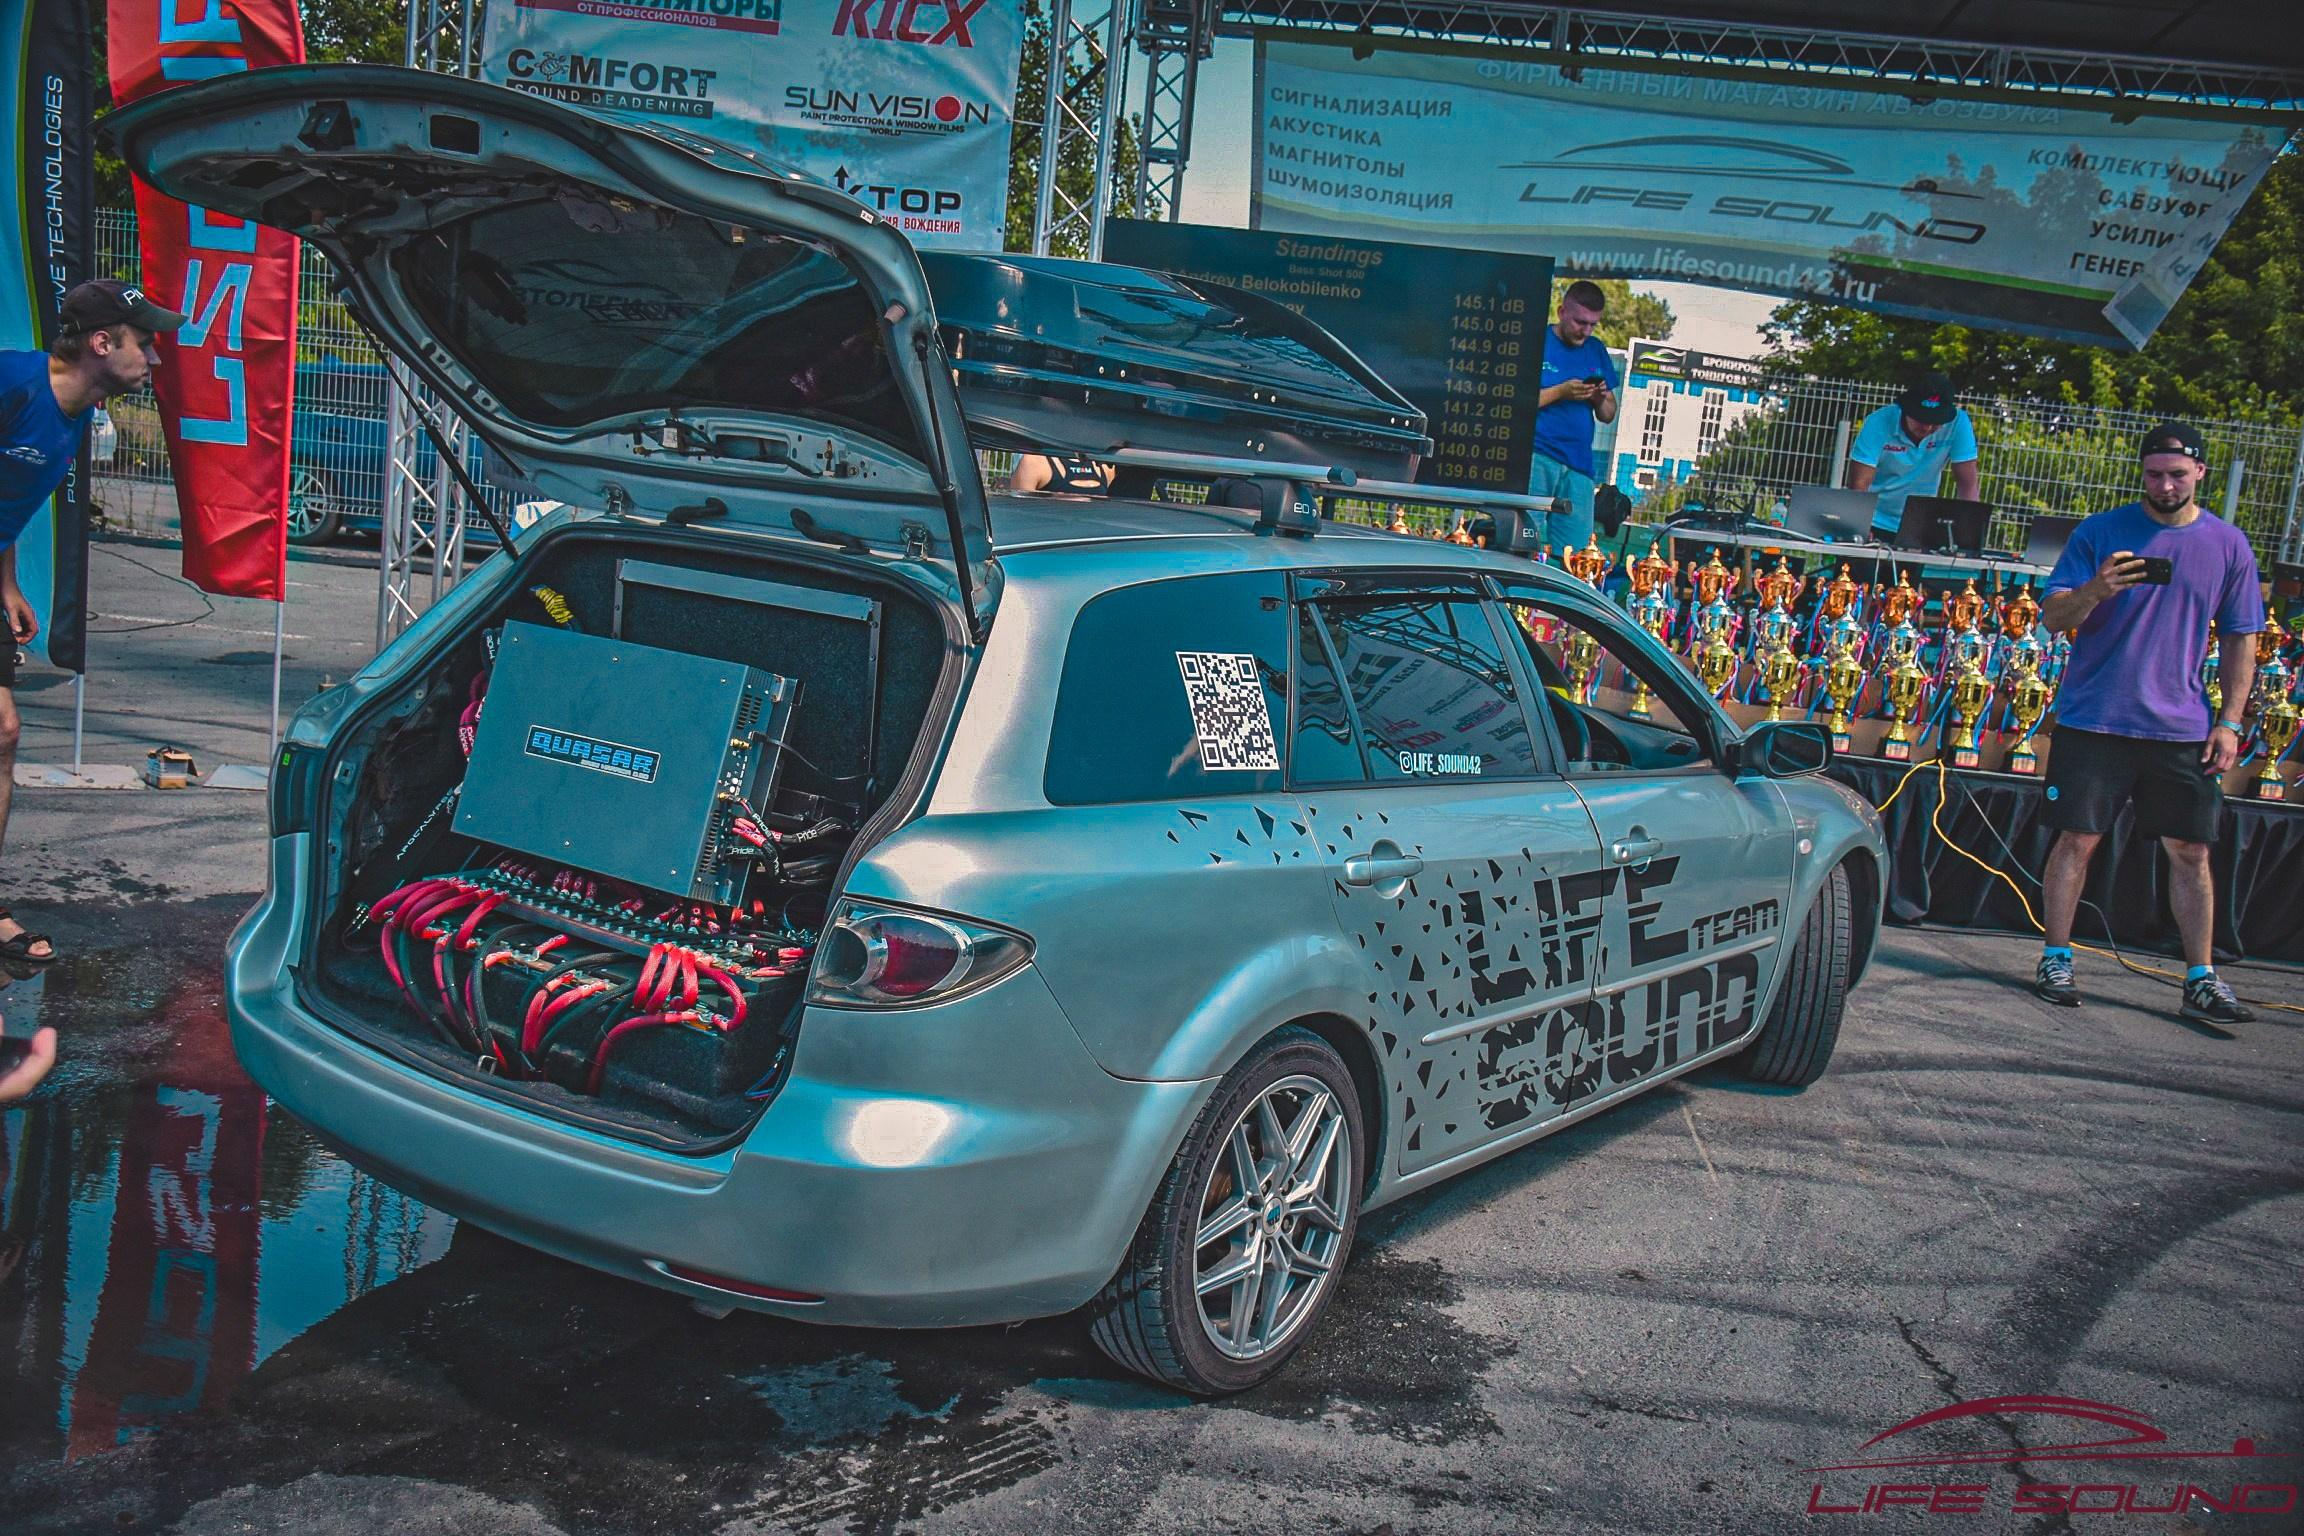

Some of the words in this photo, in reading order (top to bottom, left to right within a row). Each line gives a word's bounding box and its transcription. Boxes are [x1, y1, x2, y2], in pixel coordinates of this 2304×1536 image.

[577, 3, 593, 13] ОТ
[597, 5, 717, 26] ПРОФЕССИОНАЛОВ
[832, 0, 987, 47] KICX
[515, 84, 580, 102] SOUND
[592, 93, 704, 115] DEADENING
[784, 86, 858, 113] SUN
[1270, 87, 1452, 119] СИГНАЛИЗАЦИЯ
[1477, 60, 1691, 99] ФИРМЕННЫЙ
[1702, 79, 1858, 112] МАГАЗИН
[1868, 94, 2062, 124] АВТОЗВУКА
[800, 111, 827, 120] PAINT
[829, 113, 885, 126] PROTECTION
[894, 119, 937, 130] WINDOW
[938, 124, 965, 133] FILMS
[870, 127, 901, 136] WORLD
[1269, 115, 1382, 147] АКУСТИКА
[46, 76, 64, 257] TECHNOLOGIES
[1269, 142, 1405, 178] МАГНИТОЛЫ
[1268, 168, 1454, 212] ШУМОИЗОЛЯЦИЯ
[904, 218, 960, 233] ВОЖДЕНИЯ
[1518, 182, 1693, 211] LIFE
[1709, 196, 1988, 245] SOUND
[2090, 221, 2177, 249] УСИЛИ
[1275, 239, 1383, 267] Standings
[1289, 264, 1314, 275] Bass
[1319, 267, 1343, 278] Shot
[1346, 270, 1365, 280] 500
[1570, 247, 1878, 304] www.lifesound42.ru
[1241, 275, 1361, 299] Belokobilenko
[1454, 294, 1495, 311] 145.1
[1502, 299, 1525, 313] dB
[1452, 315, 1494, 332] 145.0
[1499, 320, 1522, 335] dB
[1450, 336, 1492, 352] 144.9
[1497, 341, 1520, 356] dB
[1447, 357, 1489, 375] 144.2
[1494, 362, 1517, 377] dB
[1492, 384, 1515, 398] dB
[1442, 400, 1485, 417] 141.2
[1490, 405, 1512, 419] dB
[1440, 421, 1482, 437] 140.5
[1487, 426, 1510, 440] dB
[1438, 442, 1480, 458] 140.0
[1485, 447, 1508, 461] dB
[1070, 466, 1092, 474] TEAM
[1436, 463, 1478, 479] 139.6
[1483, 467, 1505, 481] dB
[532, 731, 653, 773] QUASAR
[397, 787, 454, 861] APOCALYPSE
[752, 813, 772, 837] Pride
[796, 829, 818, 842] Pride
[731, 847, 754, 855] Pride
[1458, 855, 1689, 1007] LIFE
[1691, 898, 1779, 950] TEAM
[1477, 952, 1759, 1131] SOUND
[1184, 1093, 1238, 1210] EXPLORER
